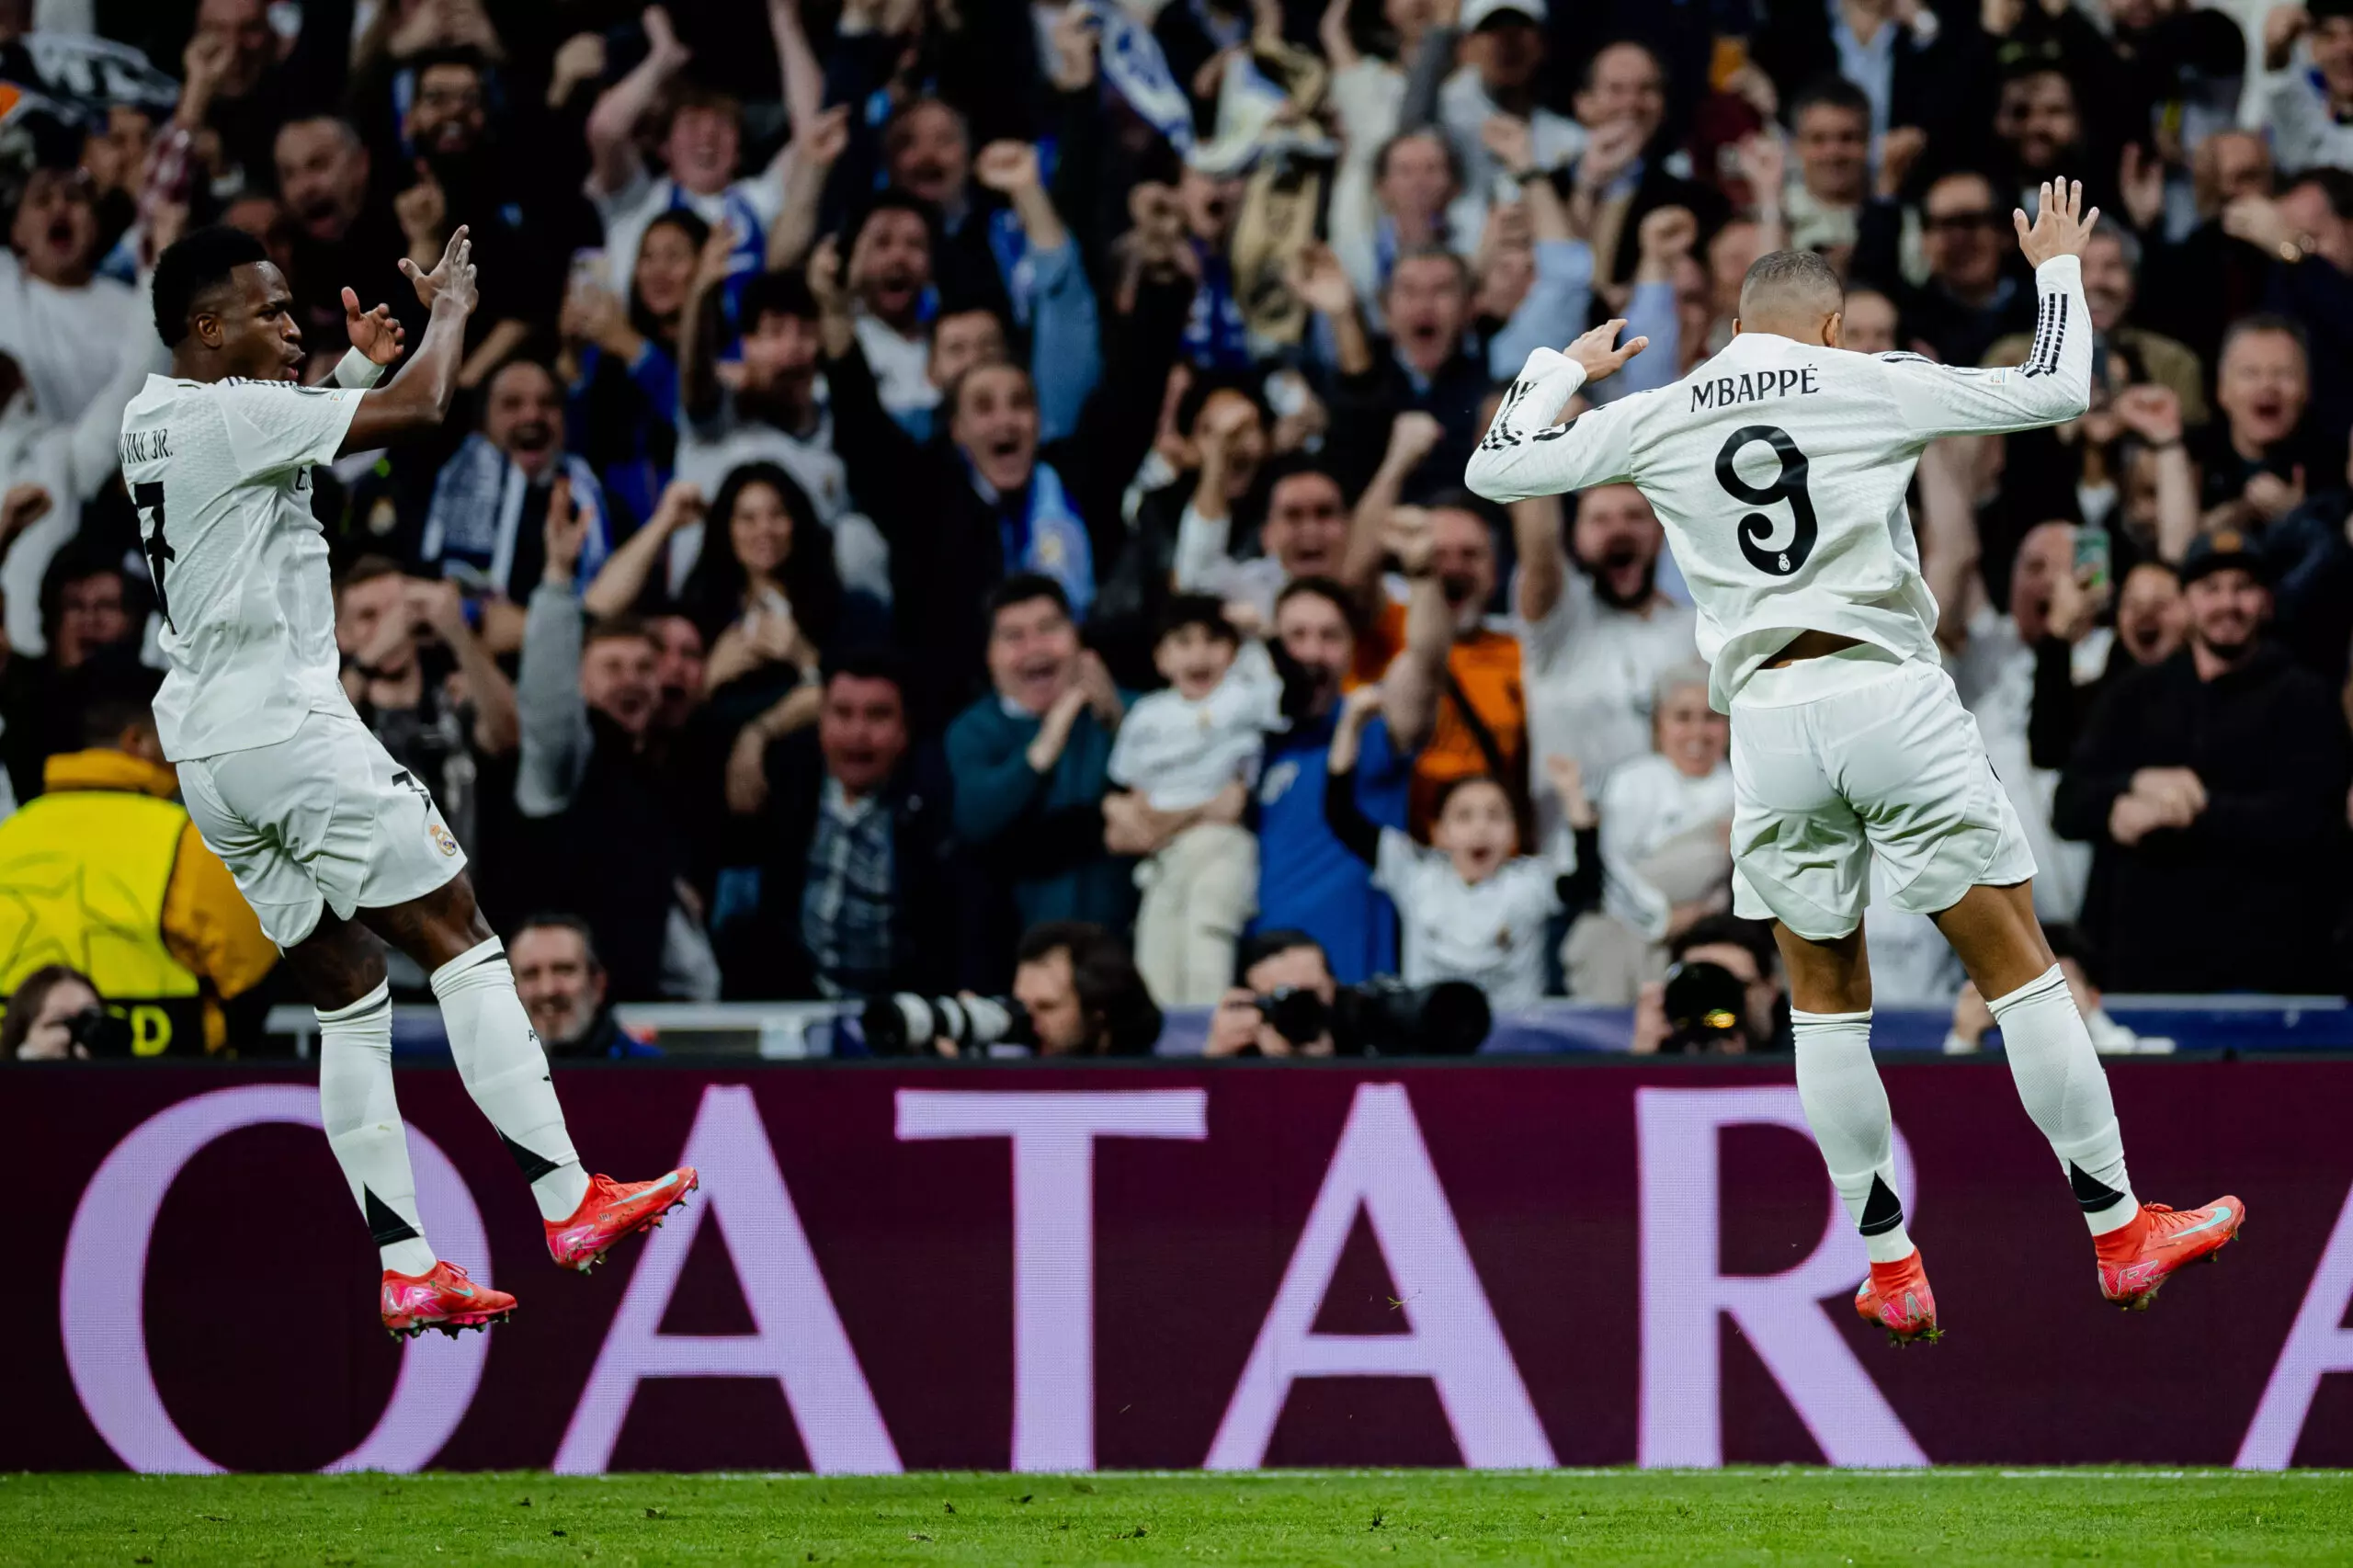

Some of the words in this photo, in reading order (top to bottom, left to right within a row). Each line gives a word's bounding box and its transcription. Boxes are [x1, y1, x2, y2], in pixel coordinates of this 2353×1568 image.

[1690, 364, 1821, 413] MBAPPÉ
[151, 428, 174, 459] JR.
[1714, 425, 1818, 576] 9
[134, 481, 177, 634] 7
